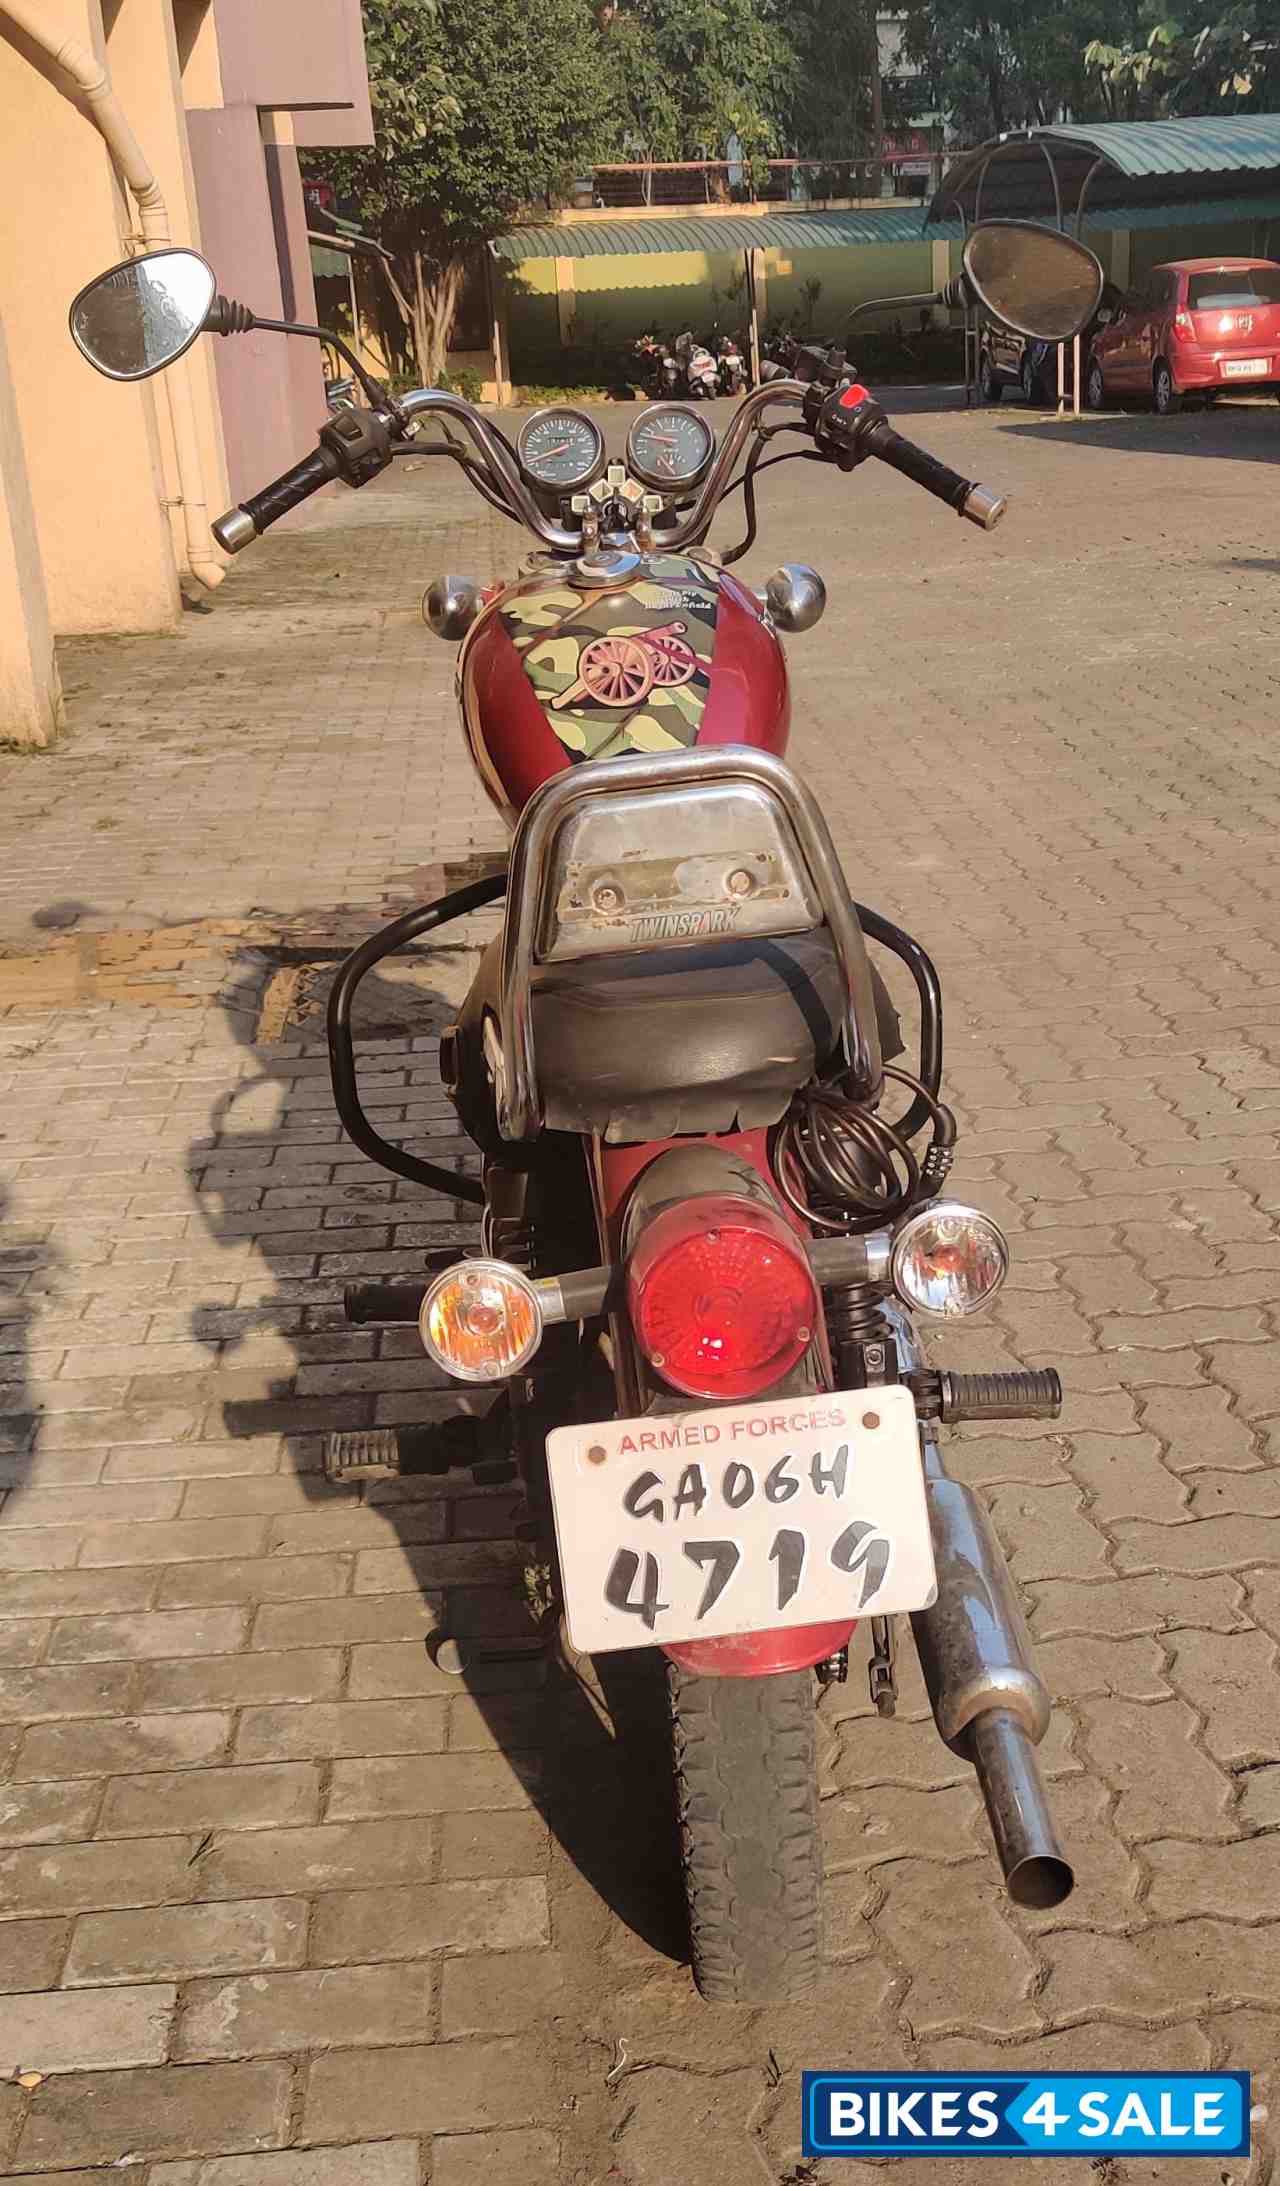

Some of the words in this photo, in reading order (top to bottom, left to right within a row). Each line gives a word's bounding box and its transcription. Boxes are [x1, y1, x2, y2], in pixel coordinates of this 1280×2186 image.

[631, 906, 740, 942] TWINSPARK
[619, 1423, 721, 1455] ARMED
[731, 1408, 847, 1441] FORCES
[605, 1521, 889, 1631] 4719
